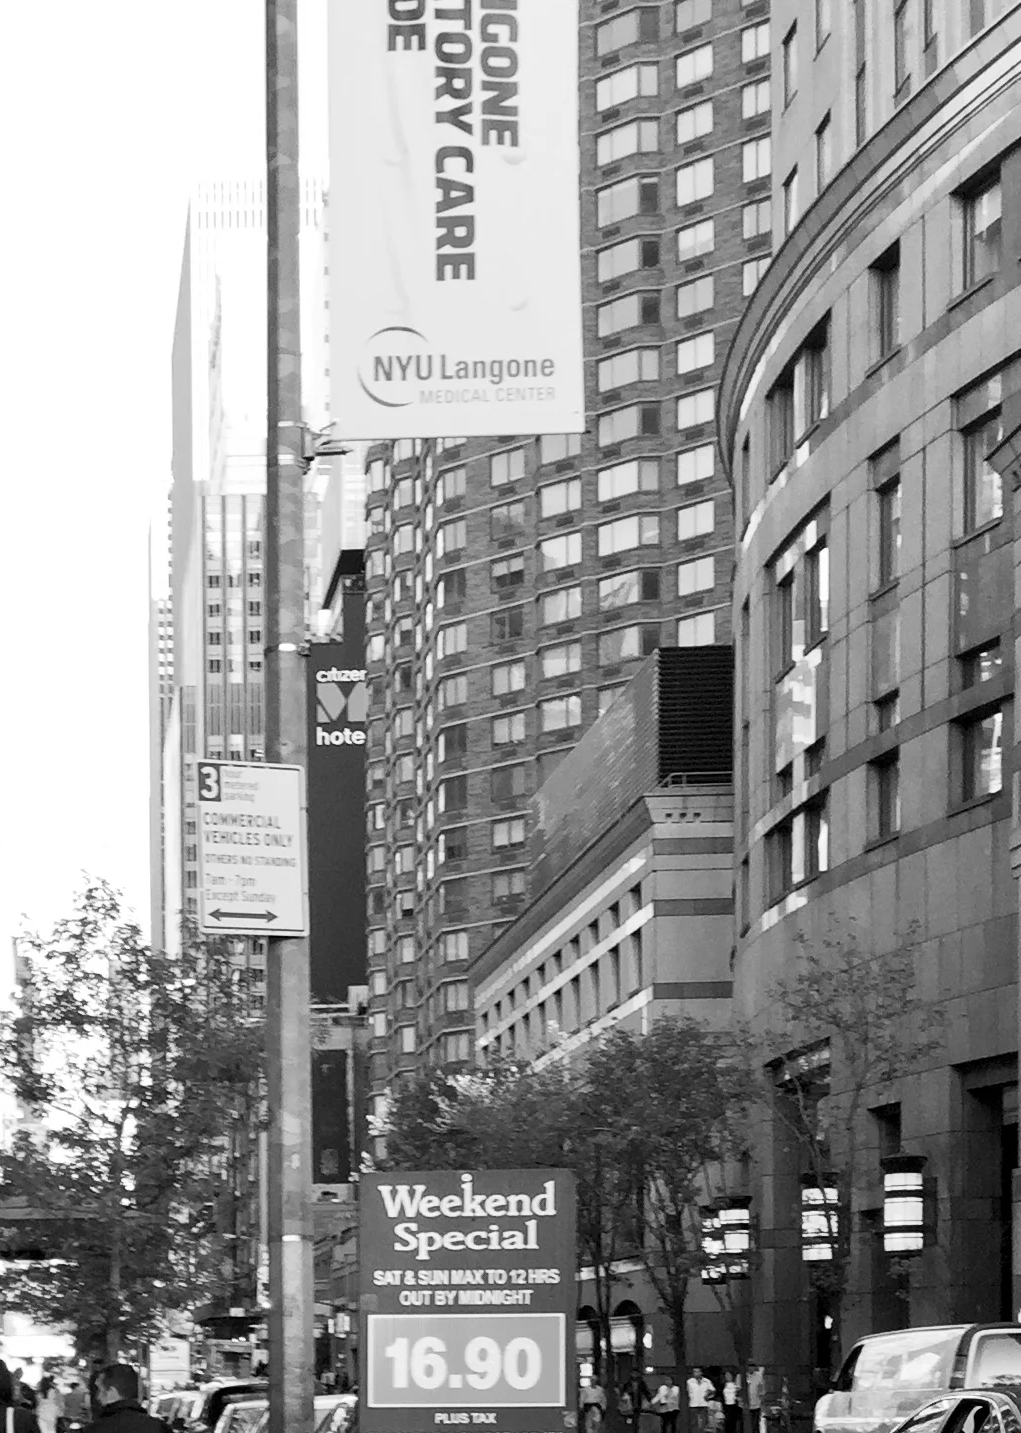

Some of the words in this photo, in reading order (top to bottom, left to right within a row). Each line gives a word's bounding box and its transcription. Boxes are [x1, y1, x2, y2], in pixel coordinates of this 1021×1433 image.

[435, 146, 476, 281] CARE
[373, 354, 432, 382] NYU
[440, 354, 556, 385] Langone
[420, 388, 491, 404] MEDICAL
[495, 386, 556, 402] CENTER
[200, 766, 219, 799] 3
[378, 1180, 557, 1218] Weekend
[394, 1220, 540, 1260] Special
[373, 1269, 403, 1286] SAT
[404, 1269, 417, 1285] &
[417, 1269, 449, 1285] SUN
[450, 1269, 485, 1285] MAX
[485, 1269, 508, 1285] TO
[509, 1269, 527, 1284] 12
[527, 1268, 561, 1284] HRS
[399, 1290, 433, 1306] OUT
[434, 1290, 457, 1306] BY
[458, 1289, 534, 1305] MIDNIGHT
[384, 1336, 543, 1390] 16.90
[434, 1412, 470, 1425] PLUS
[470, 1412, 497, 1424] TAX
